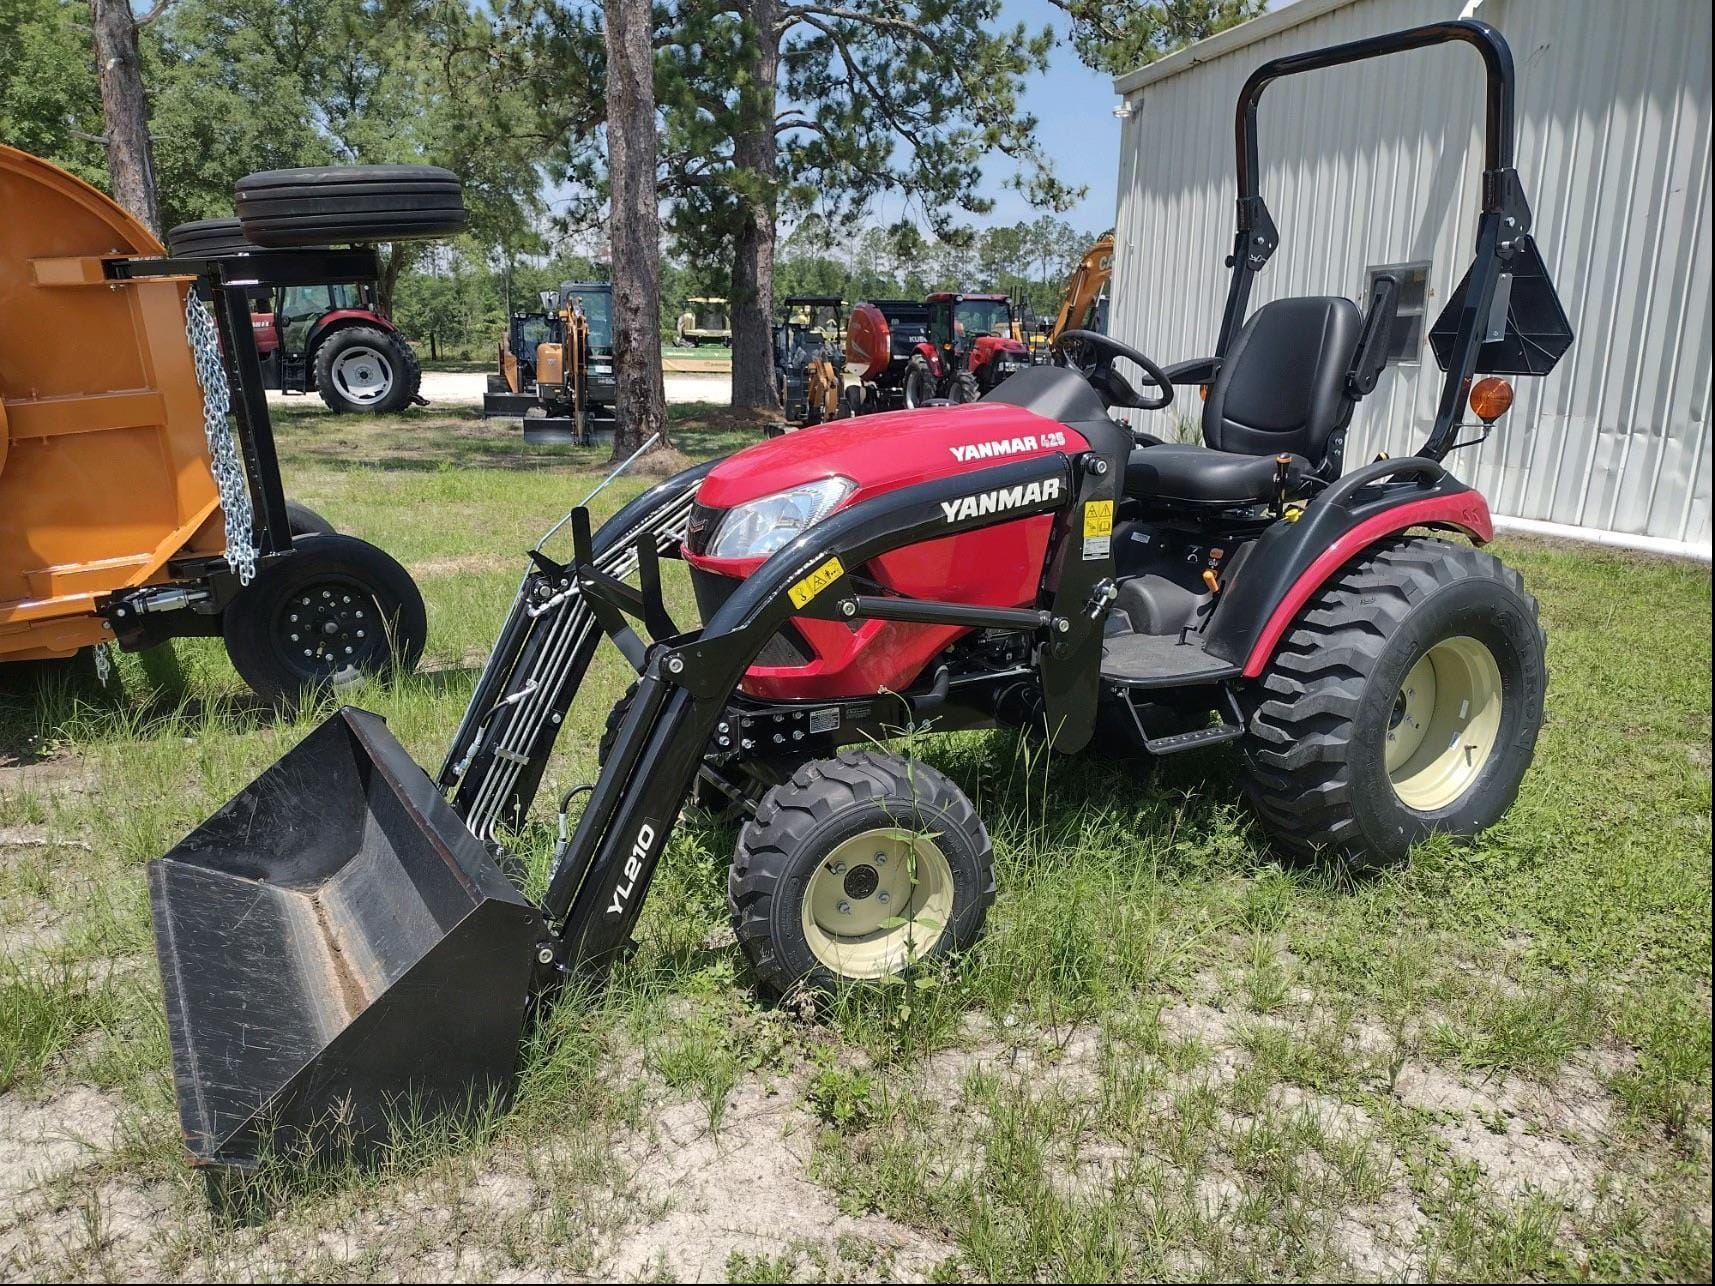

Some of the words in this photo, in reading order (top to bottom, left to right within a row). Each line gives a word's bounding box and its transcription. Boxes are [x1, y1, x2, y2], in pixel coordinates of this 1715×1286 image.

[950, 436, 1037, 462] YANMAR
[1041, 432, 1066, 449] 425
[941, 478, 1060, 523] YANMAR
[606, 824, 654, 914] YL210
